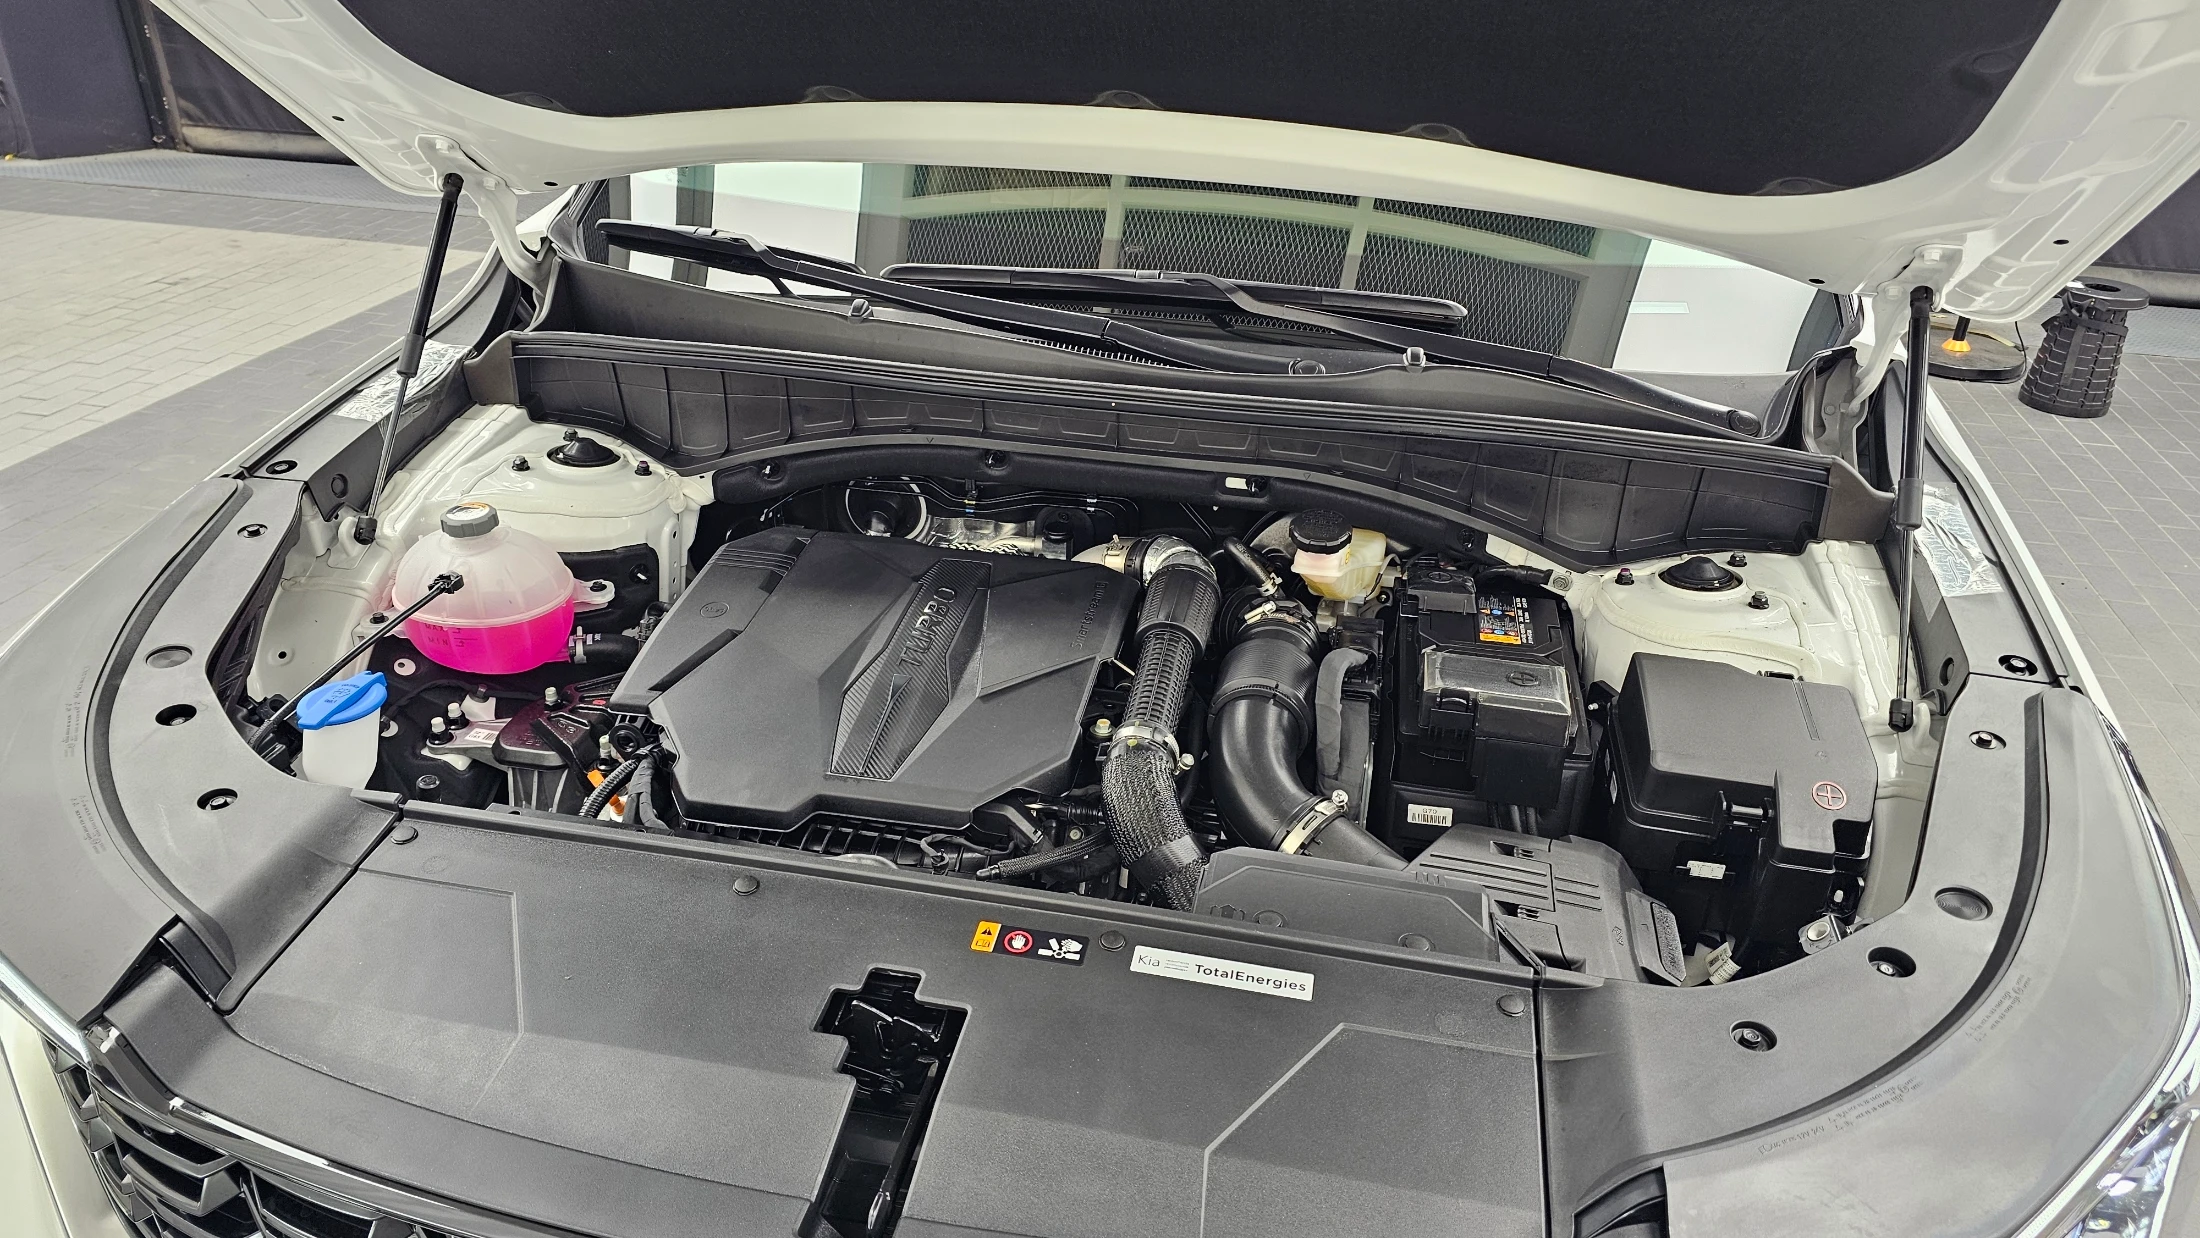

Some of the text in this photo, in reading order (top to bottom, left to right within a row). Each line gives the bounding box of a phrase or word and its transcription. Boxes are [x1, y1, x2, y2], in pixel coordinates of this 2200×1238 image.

[896, 587, 957, 667] TURBO
[1137, 954, 1307, 992] Kia TotalEnergies
